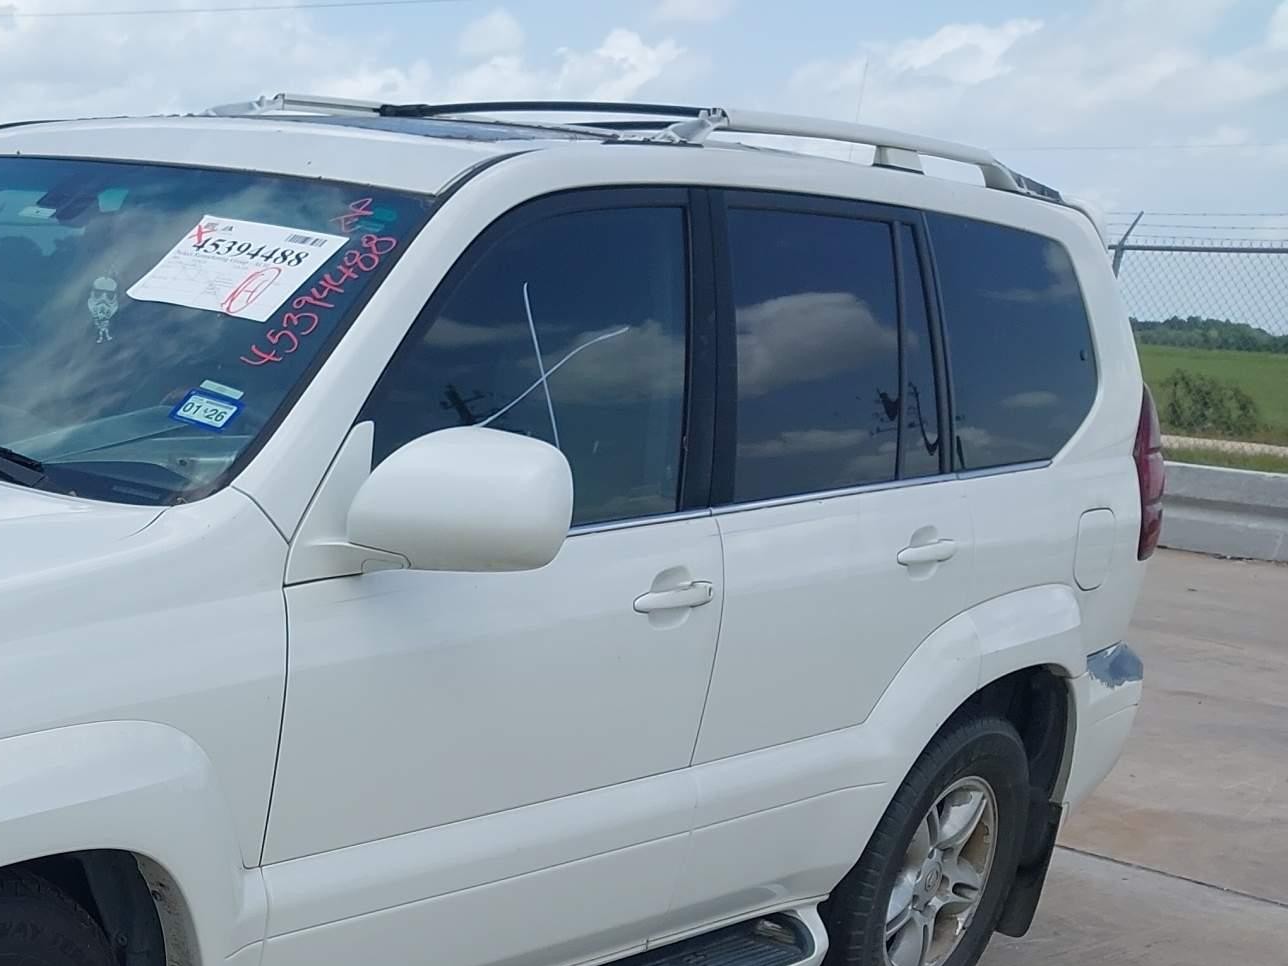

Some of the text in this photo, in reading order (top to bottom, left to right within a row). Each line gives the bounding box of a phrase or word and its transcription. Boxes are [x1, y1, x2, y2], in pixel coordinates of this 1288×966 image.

[192, 236, 310, 268] 45394488
[240, 234, 397, 366] 45394488
[182, 401, 203, 415] 01
[205, 408, 228, 422] 26
